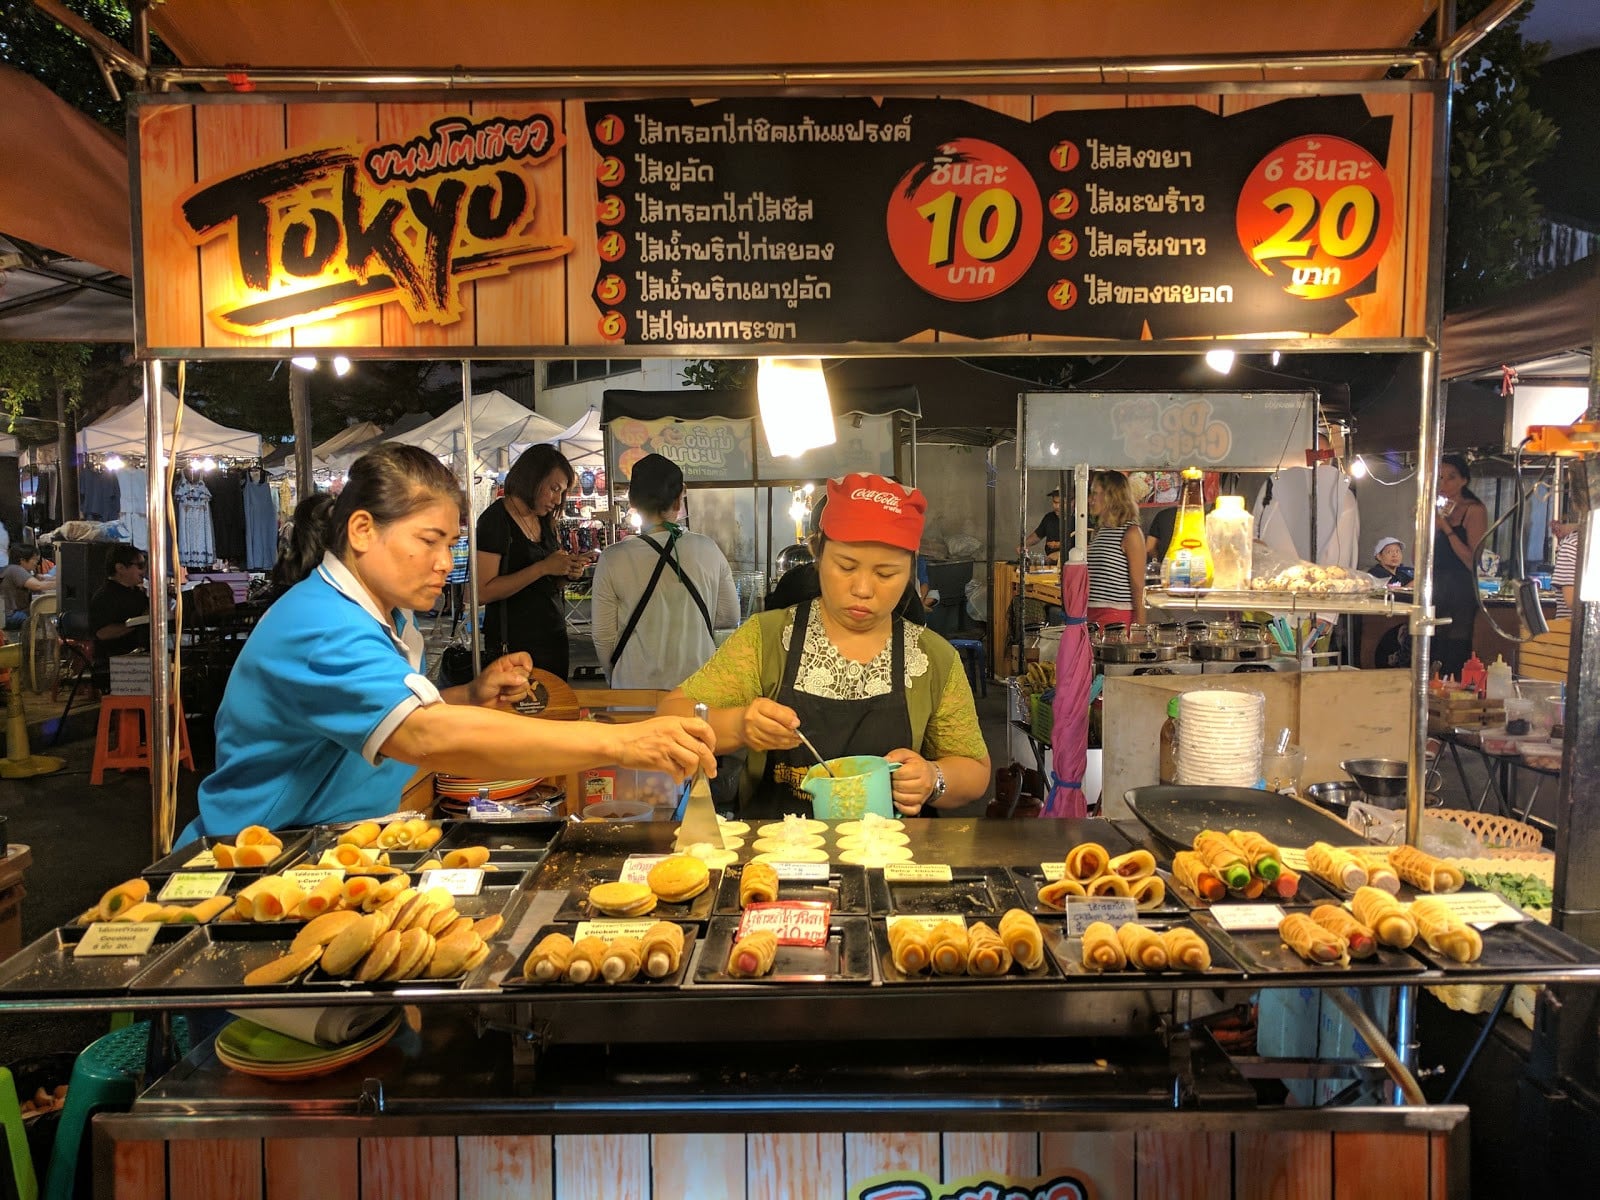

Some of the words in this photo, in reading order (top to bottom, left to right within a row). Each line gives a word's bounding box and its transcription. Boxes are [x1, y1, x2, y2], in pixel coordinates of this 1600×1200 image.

[370, 116, 555, 181] ขนมโตเกียว
[1086, 139, 1193, 170] ไส้สังขยา
[1264, 157, 1285, 182] 6
[1293, 140, 1373, 182] ชิ้นละ
[634, 153, 715, 190] ไส้ปูอัด
[930, 148, 1009, 186] ชิ้นละ
[634, 191, 814, 224] ไส้กรอกไก่ไส้ชีส
[1086, 183, 1206, 215] ไส้มะพร้าว
[917, 187, 1020, 269] 10
[1252, 184, 1380, 262] 20
[635, 230, 835, 263] ไส้น้ำพริกไก่หยอง
[1085, 226, 1207, 258] ไส้ครีมขาว
[635, 268, 831, 308] ไส้น้ำพริกเผาปูอัด
[947, 265, 996, 285] บาท
[1085, 273, 1234, 306] ไส้ทองหยอด
[1291, 266, 1342, 286] บาท
[635, 310, 797, 341] ไส้ไข่นกกระทา
